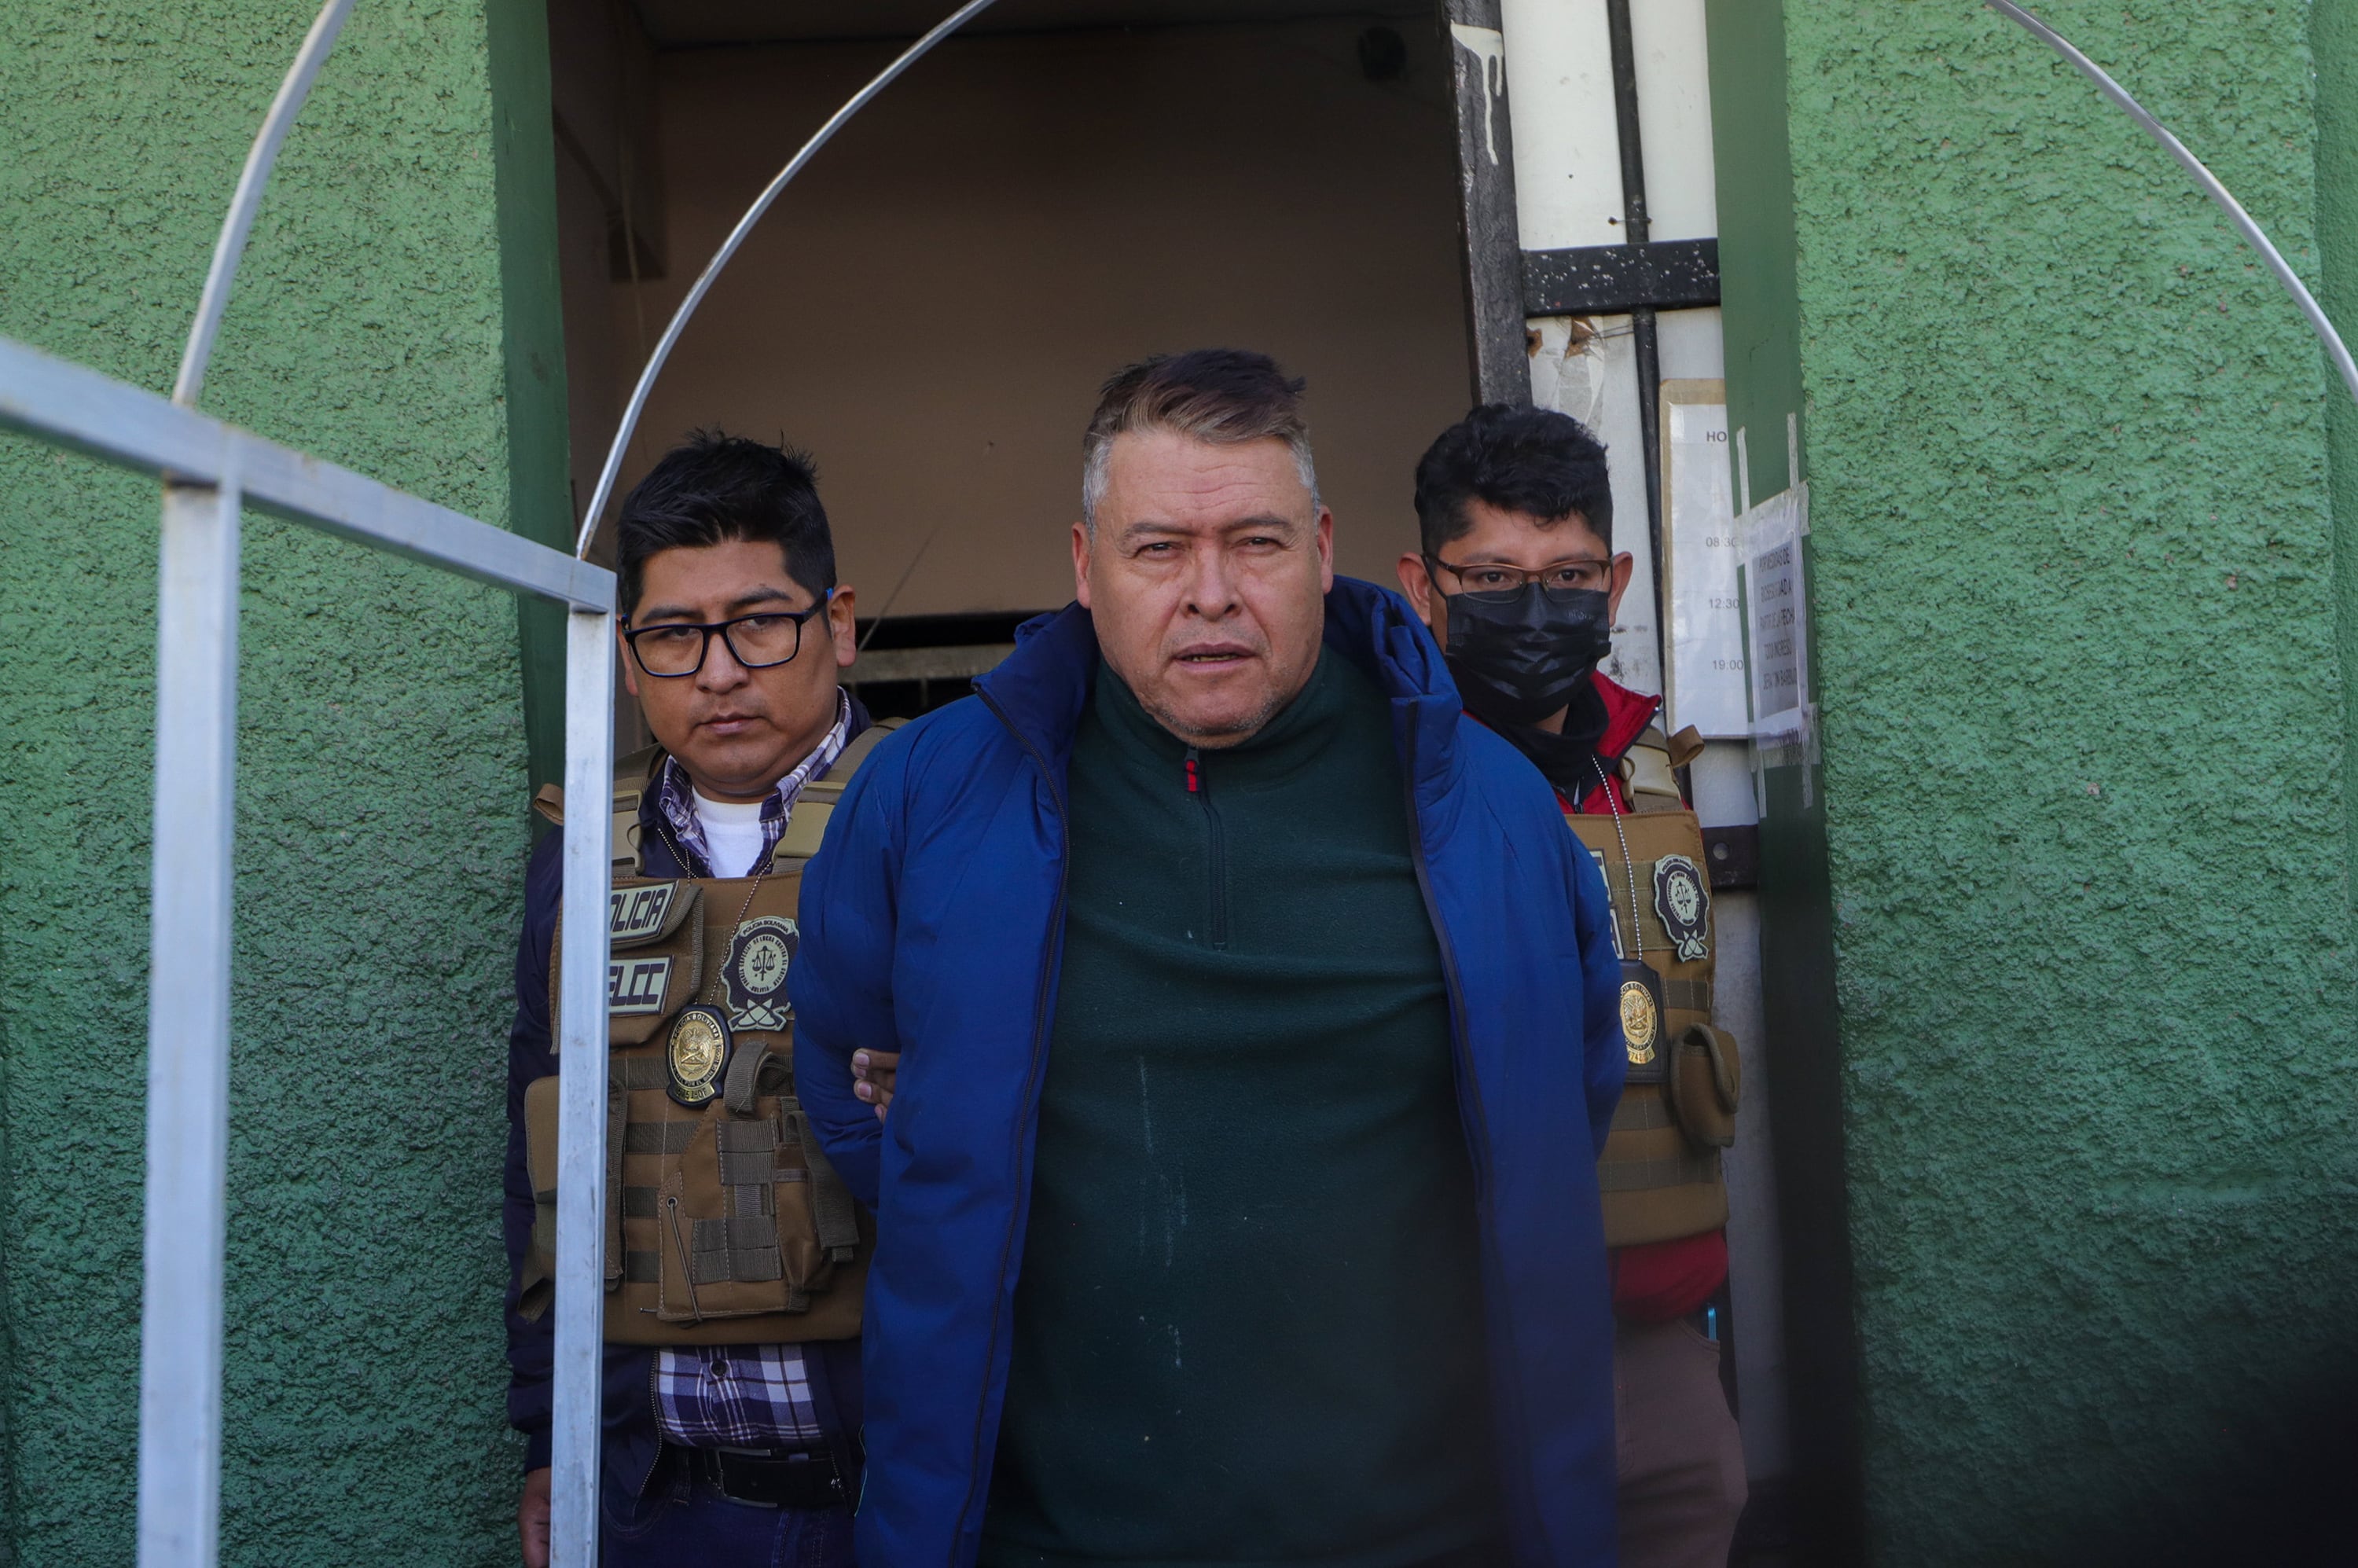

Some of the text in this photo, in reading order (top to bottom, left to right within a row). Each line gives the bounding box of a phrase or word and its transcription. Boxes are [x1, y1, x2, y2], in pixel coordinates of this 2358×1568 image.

[1710, 598, 1739, 609] 12:30
[1713, 660, 1744, 670] 19:00
[692, 1013, 720, 1038] BOLIVIANA
